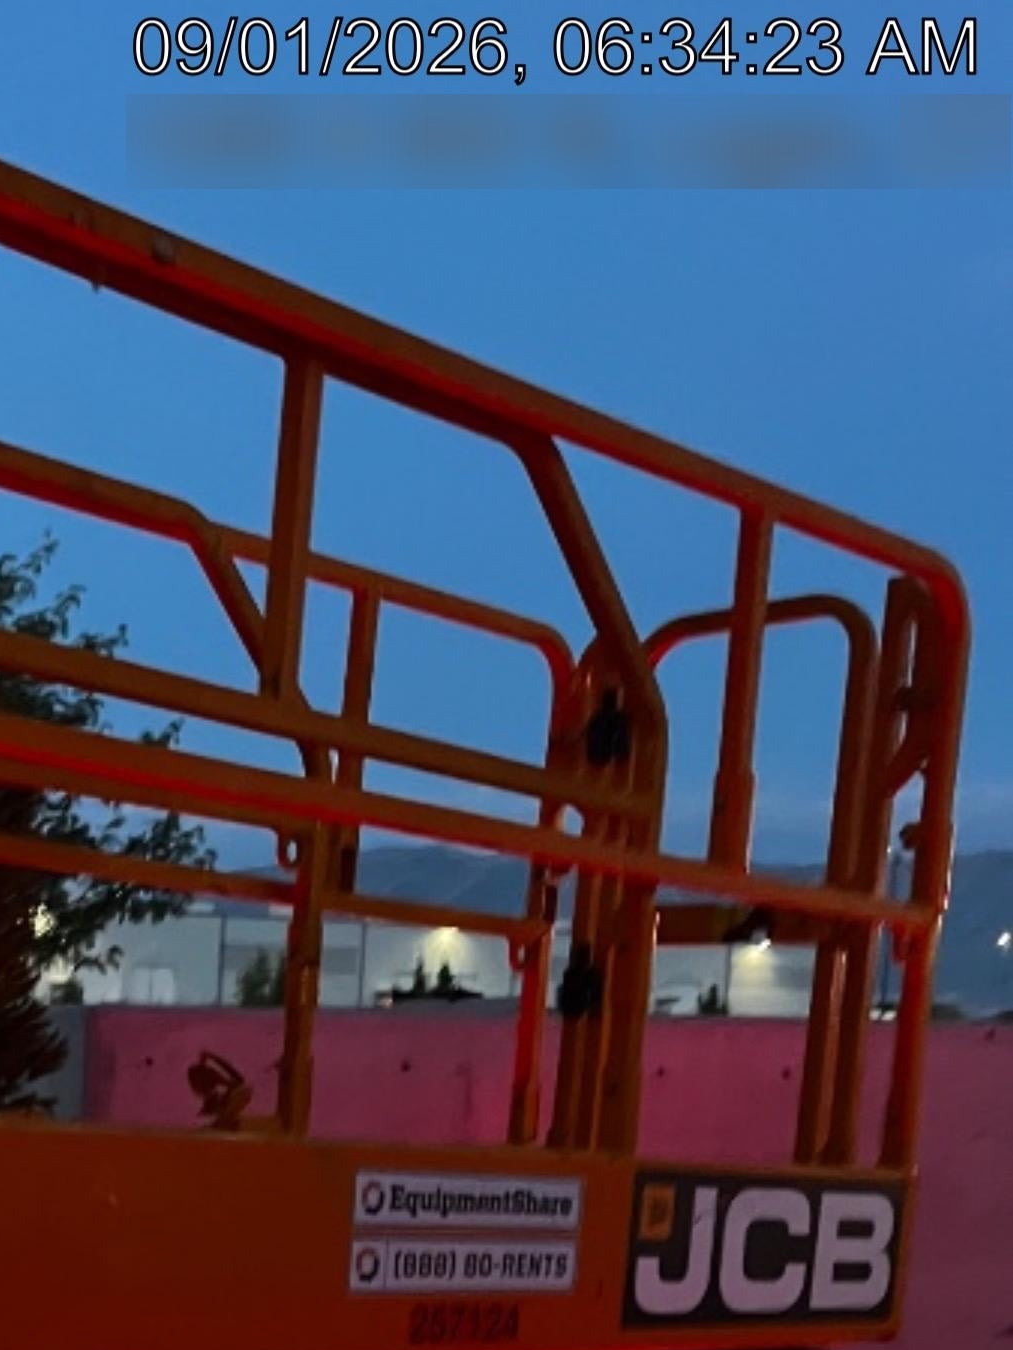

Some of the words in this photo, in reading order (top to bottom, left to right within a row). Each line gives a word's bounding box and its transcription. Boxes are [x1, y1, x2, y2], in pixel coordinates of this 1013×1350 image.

[390, 1183, 573, 1219] EquipmentShare
[635, 1186, 895, 1315] JCB
[408, 1302, 520, 1344] 257124
